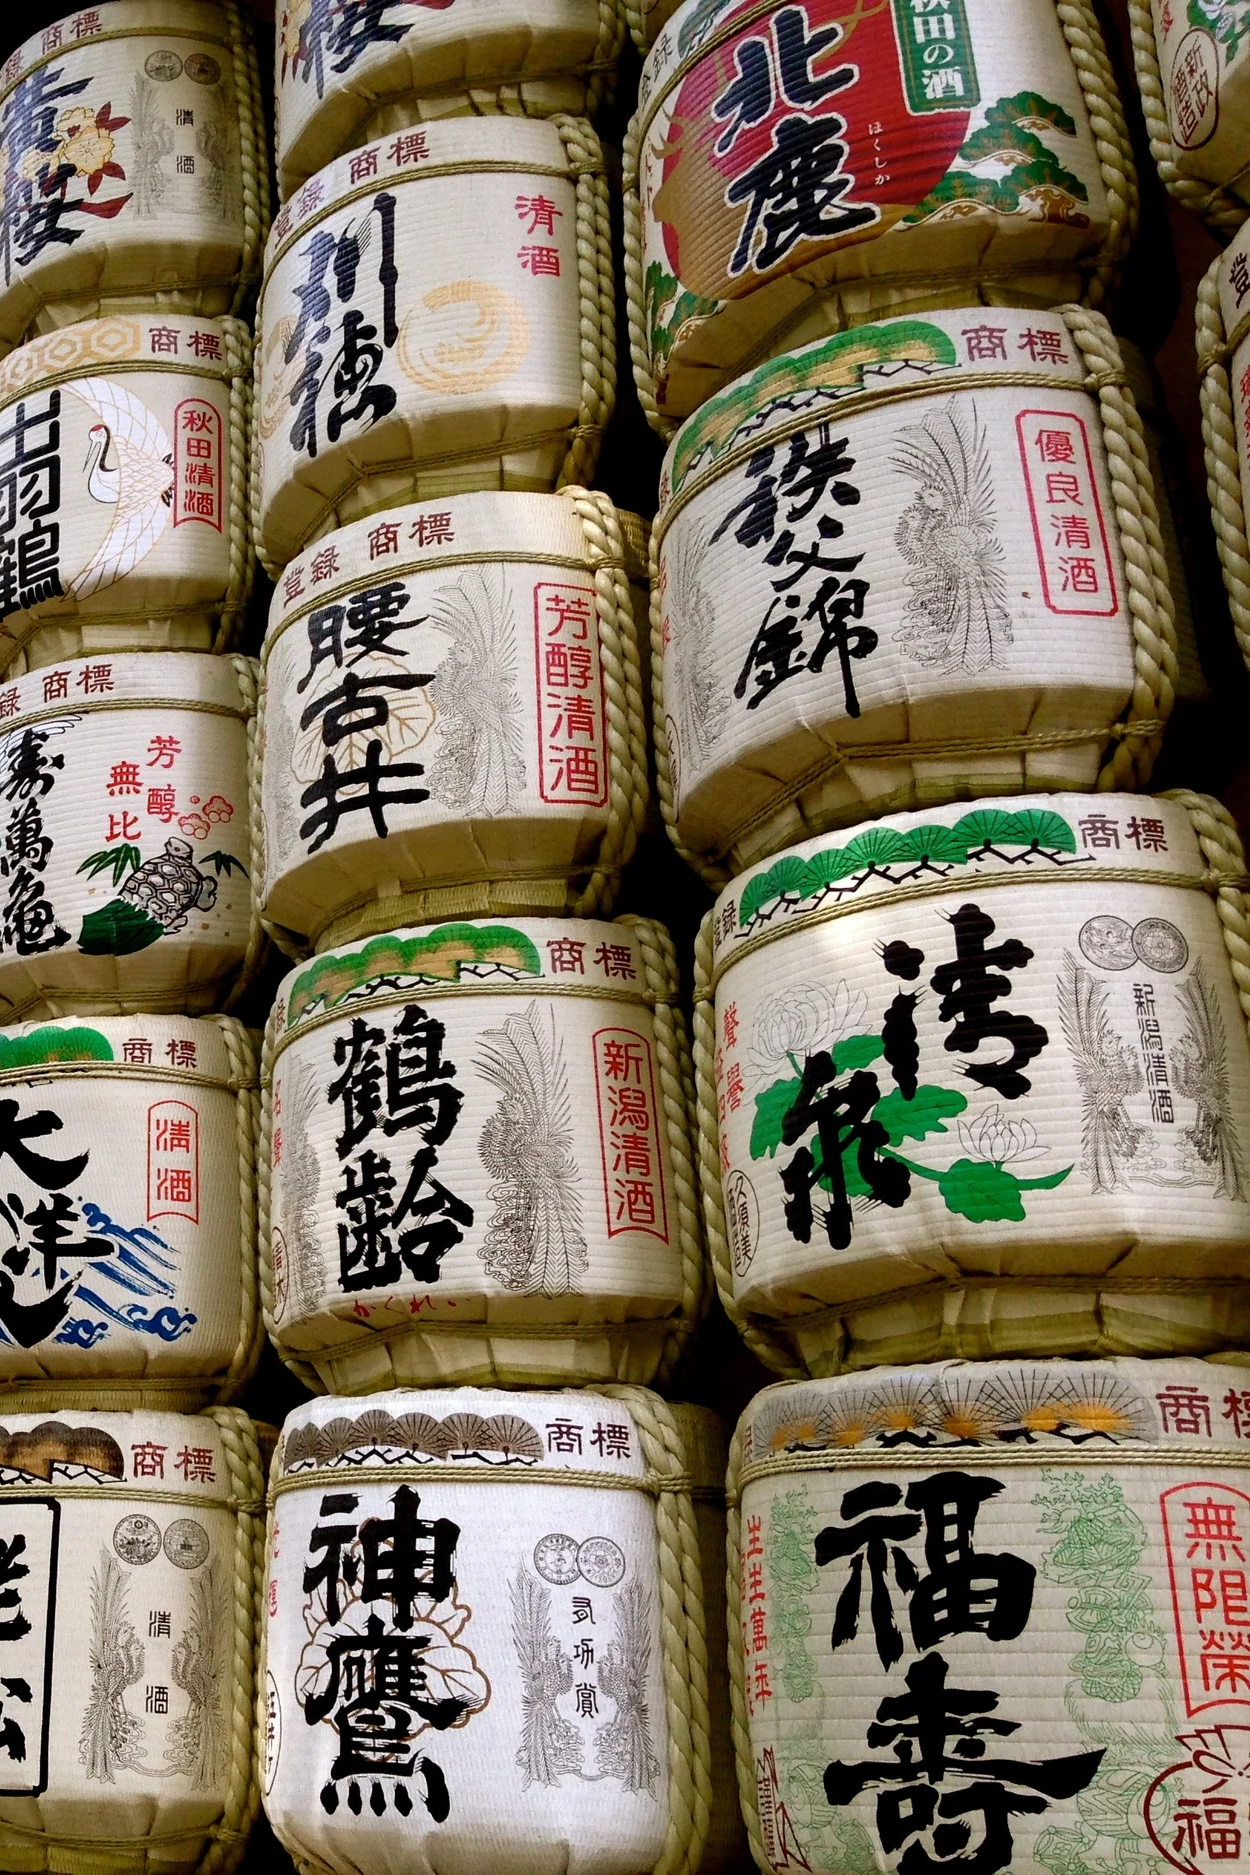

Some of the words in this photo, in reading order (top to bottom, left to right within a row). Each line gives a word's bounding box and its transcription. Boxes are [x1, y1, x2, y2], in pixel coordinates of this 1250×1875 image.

[175, 108, 195, 175] 清酒
[712, 5, 880, 278] 北鹿
[867, 121, 892, 186] ほくしか
[514, 194, 565, 278] 清酒
[148, 325, 224, 362] 商標
[961, 324, 1070, 366] 商標
[181, 408, 217, 518] 秋田清酒
[1034, 427, 1098, 594] 優良清酒
[710, 417, 879, 719] 秩父錦
[297, 581, 437, 856] 腰古井
[544, 593, 600, 797] 芳醇清酒
[104, 760, 144, 843] 無比
[146, 735, 182, 824] 芳醇
[1077, 813, 1170, 853] 商標
[546, 937, 638, 981] 商標
[121, 1037, 198, 1070] 商標
[155, 1118, 193, 1204] 清酒
[602, 1038, 658, 1226] 新潟清酒
[130, 1440, 218, 1484] 商標
[544, 1417, 633, 1461] 商標
[144, 1609, 172, 1716] 清酒
[302, 1483, 472, 1824] 神鷹
